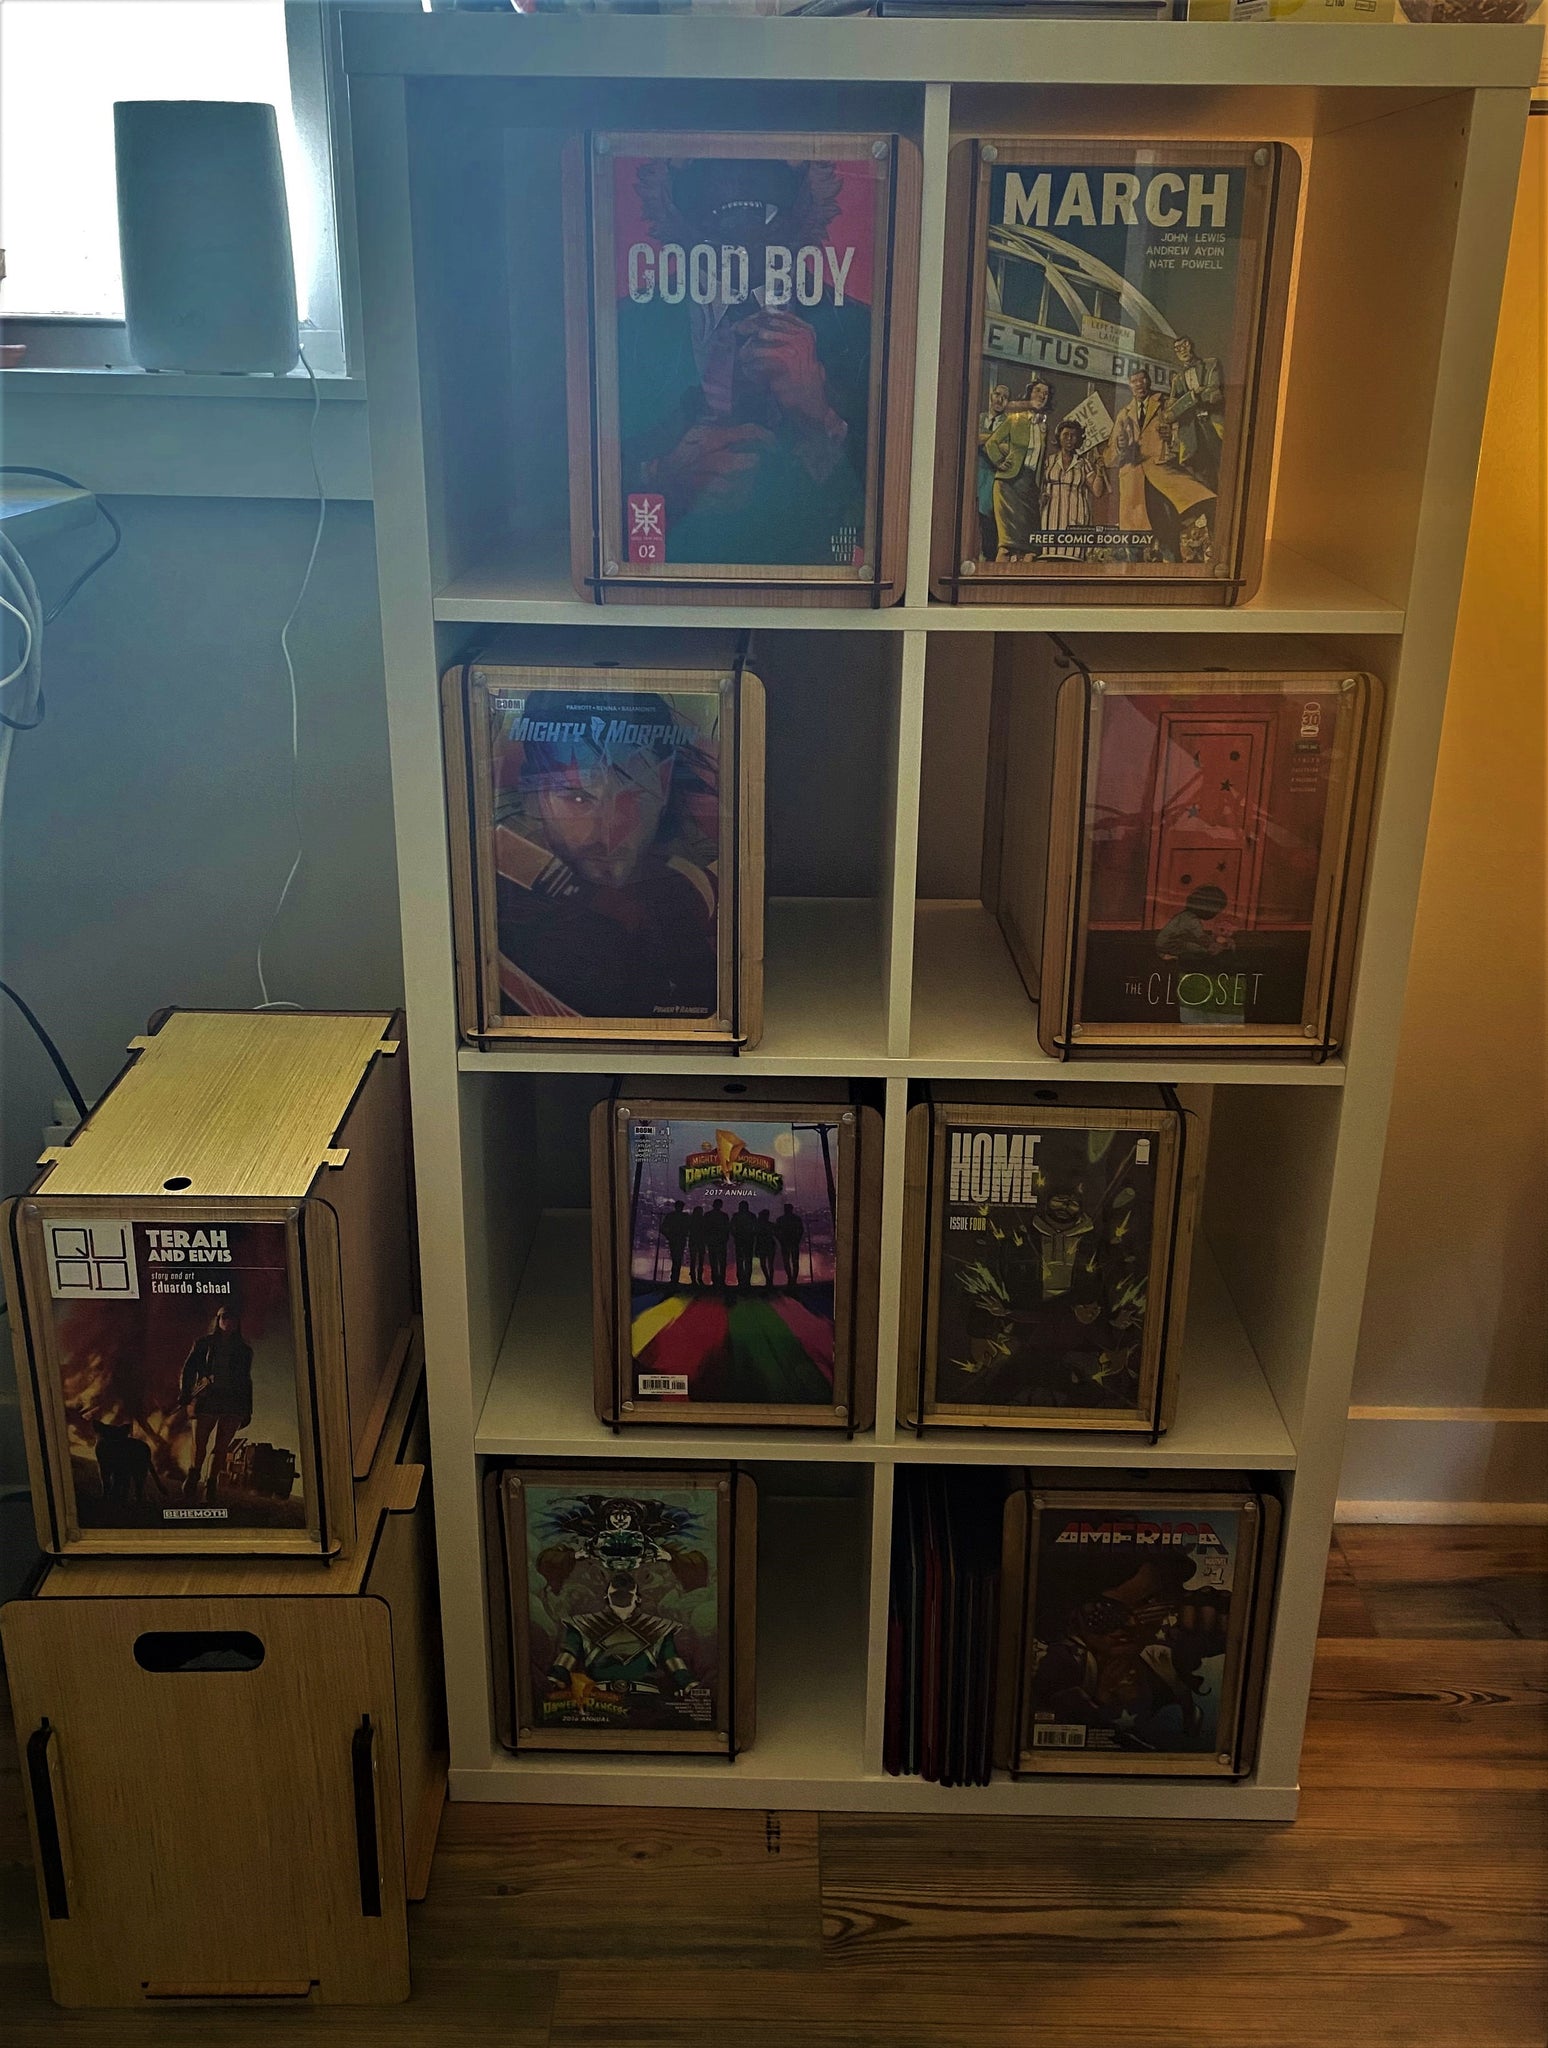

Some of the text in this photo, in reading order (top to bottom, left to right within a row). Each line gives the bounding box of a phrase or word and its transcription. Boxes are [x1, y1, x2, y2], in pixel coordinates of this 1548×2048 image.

[1003, 172, 1229, 227] MARCH
[1161, 232, 1226, 243] JOHN LEWIS
[1146, 246, 1225, 257] ANDREW AYDIN
[1149, 259, 1223, 270] NATE POWELL
[628, 243, 855, 307] GOOD BOY
[988, 324, 1089, 370] ETTUS
[1029, 534, 1154, 544] FREE COMIC BOOK DAY
[638, 544, 656, 558] 02
[508, 717, 699, 746] MIGHTY MORPHIN
[1125, 972, 1263, 1006] THE CLOSET
[950, 1132, 1041, 1204] HOME
[732, 1161, 781, 1190] RANGERS
[725, 1189, 758, 1197] ANNUAL
[949, 1216, 987, 1231] ISSUE FOUR
[145, 1229, 228, 1249] TERAH
[148, 1249, 233, 1263] AND ELVIS
[151, 1272, 195, 1281] story and art
[152, 1281, 231, 1294] Eduardo Schaal
[164, 1509, 227, 1519] BEHEMOTH
[1055, 1521, 1228, 1554] AMERICA
